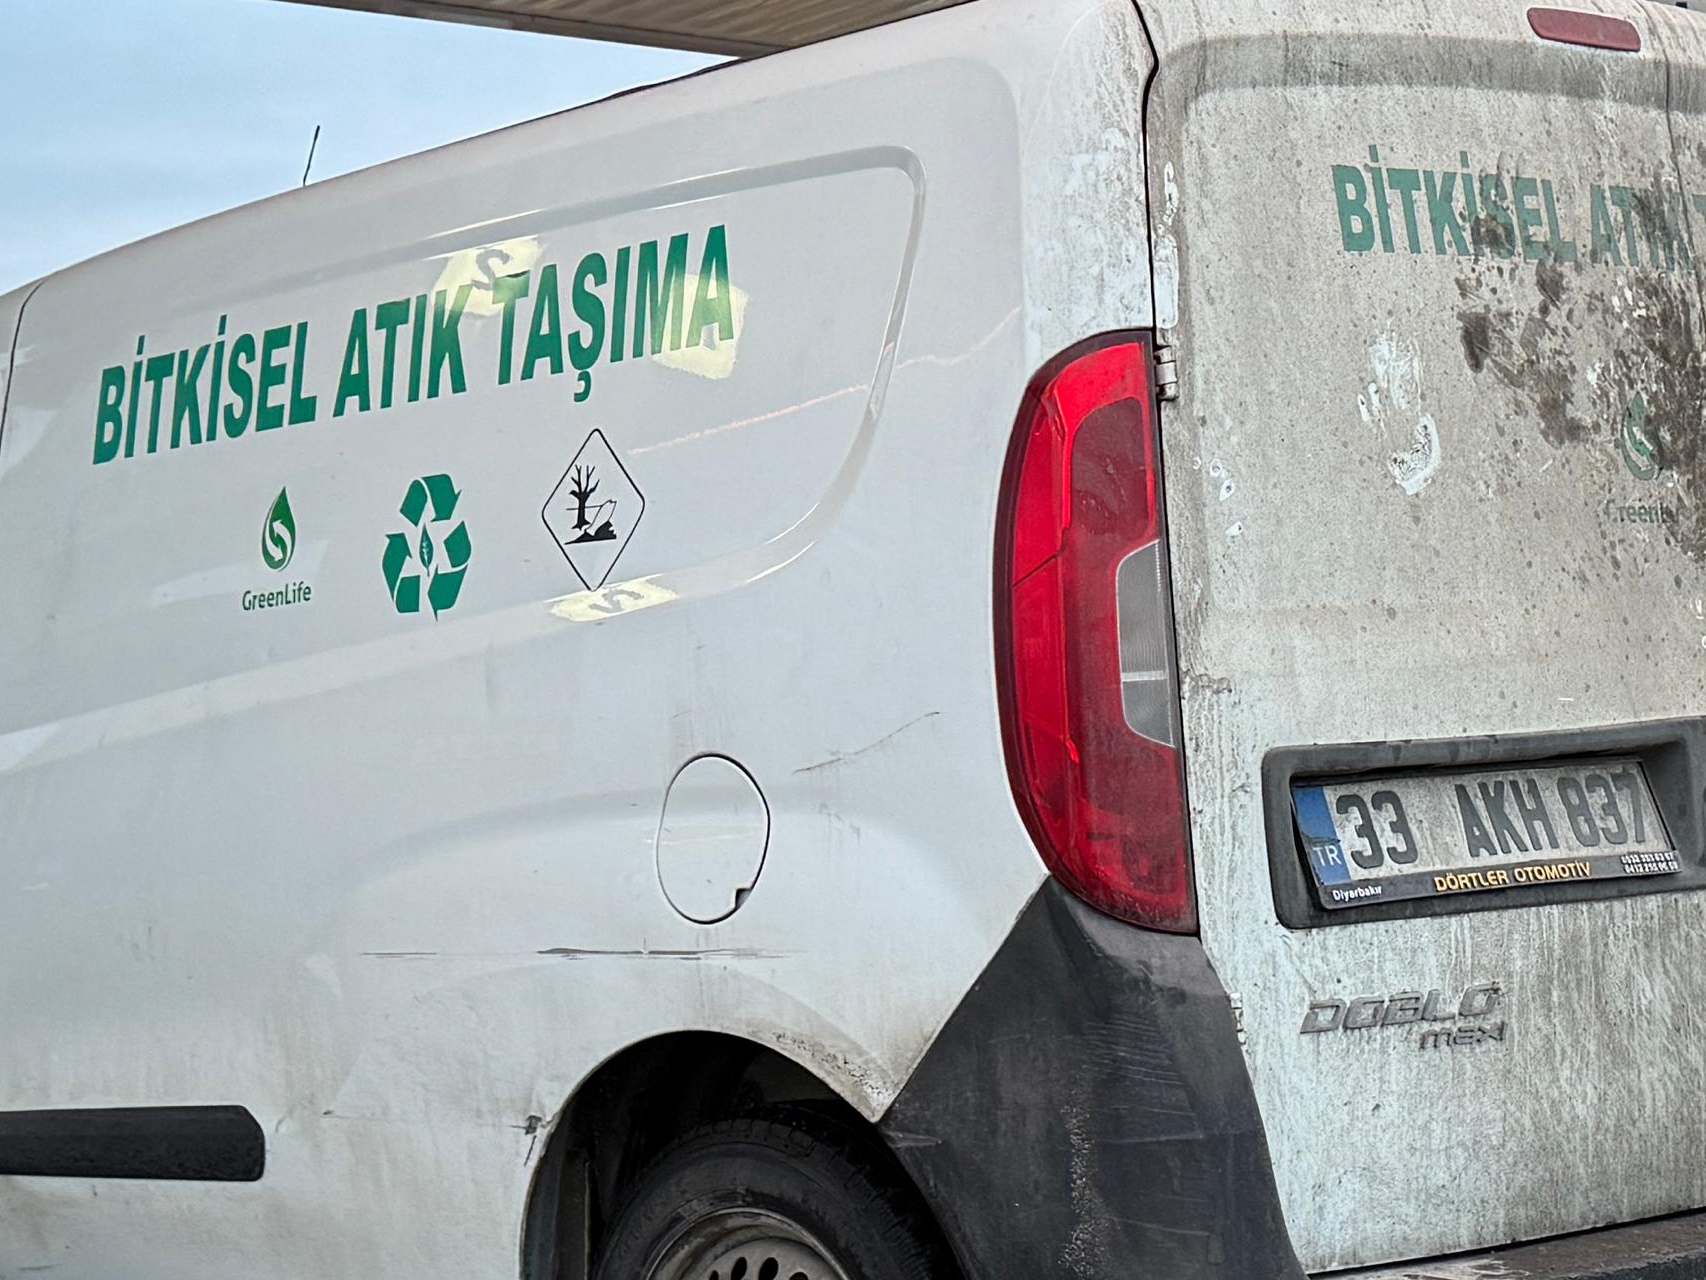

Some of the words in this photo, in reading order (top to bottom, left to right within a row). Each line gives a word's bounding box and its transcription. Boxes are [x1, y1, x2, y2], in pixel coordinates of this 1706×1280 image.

[1331, 143, 1578, 264] BİTKİSEL
[92, 314, 319, 465] BİTKİSEL
[333, 284, 475, 418] ATIK
[491, 224, 735, 404] TAŞIMA
[242, 580, 312, 612] GreenLife
[1335, 790, 1418, 869] 33
[1453, 777, 1560, 858] AKH
[1555, 771, 1646, 847] 837
[1313, 844, 1343, 867] TR
[1433, 869, 1510, 894] DÖRTLER
[1514, 859, 1591, 886] OTOMOTİV
